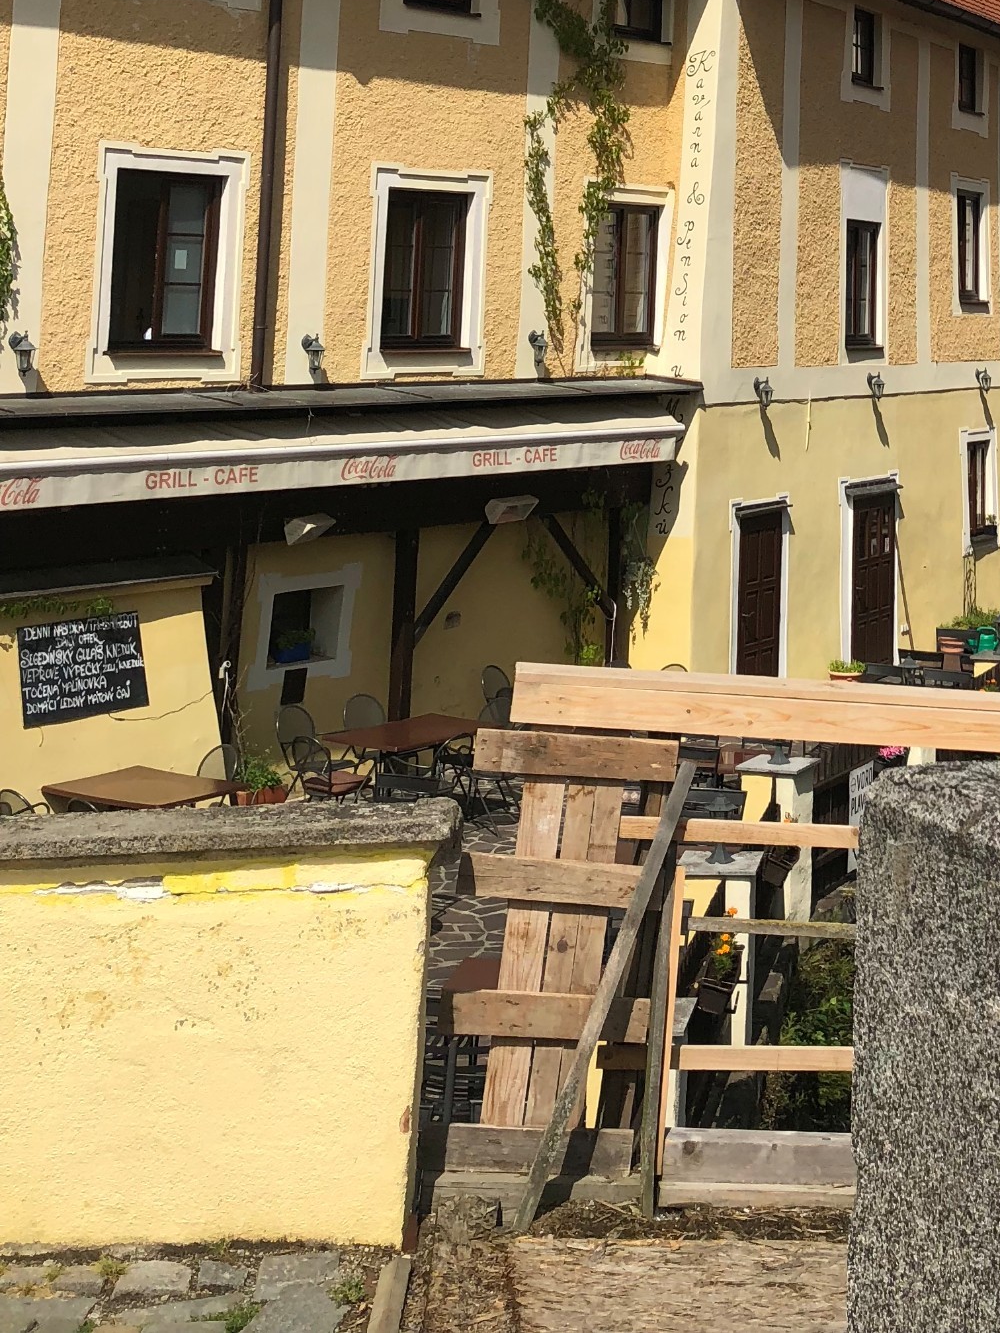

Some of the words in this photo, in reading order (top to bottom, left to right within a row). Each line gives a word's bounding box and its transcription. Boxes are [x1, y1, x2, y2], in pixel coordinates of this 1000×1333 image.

[686, 49, 716, 168] Kavárna
[472, 452, 512, 467] GRILL
[524, 448, 558, 464] CAFE
[620, 438, 661, 460] Coca-Cola
[145, 470, 198, 490] GRILL
[214, 466, 259, 485] CAFE
[341, 454, 398, 481] Coca-Cola
